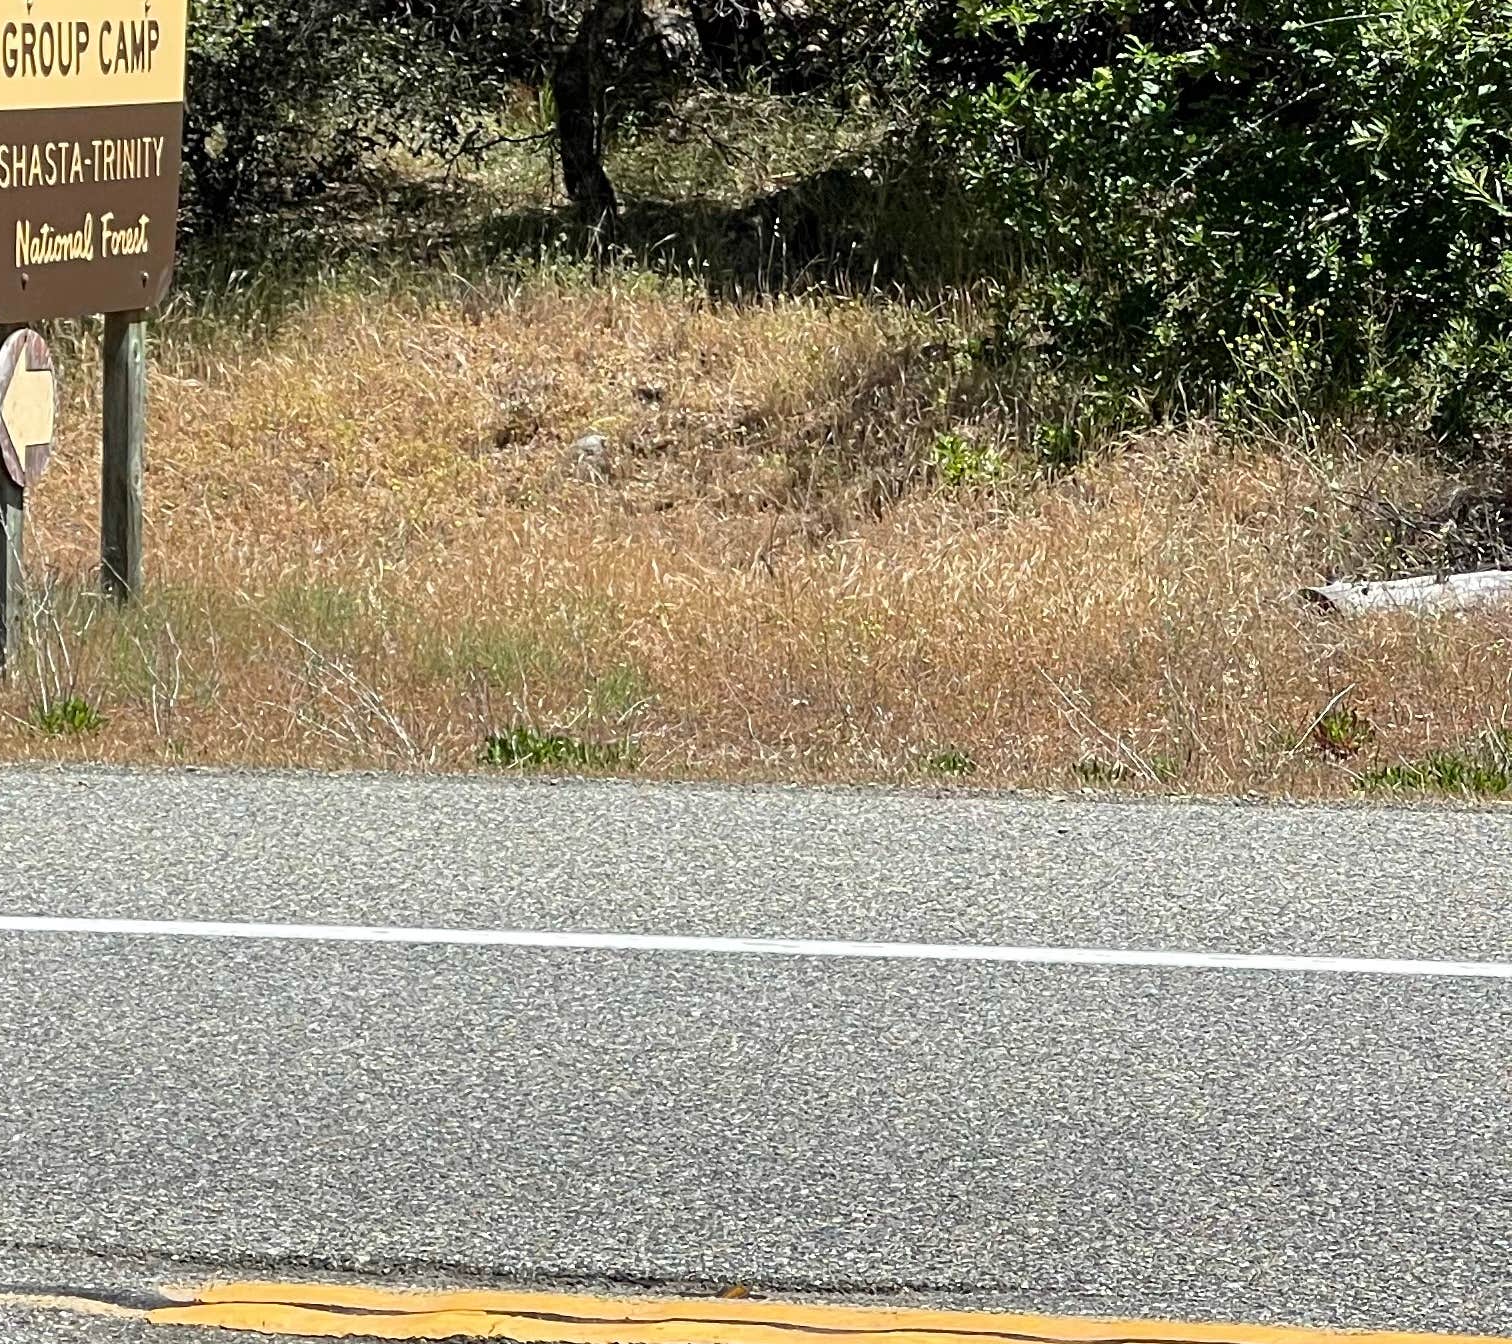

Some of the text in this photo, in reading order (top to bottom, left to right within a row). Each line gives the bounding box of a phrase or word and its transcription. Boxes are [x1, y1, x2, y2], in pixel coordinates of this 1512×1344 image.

[1, 19, 160, 79] GROUP CAMP
[15, 211, 151, 268] National Forest
